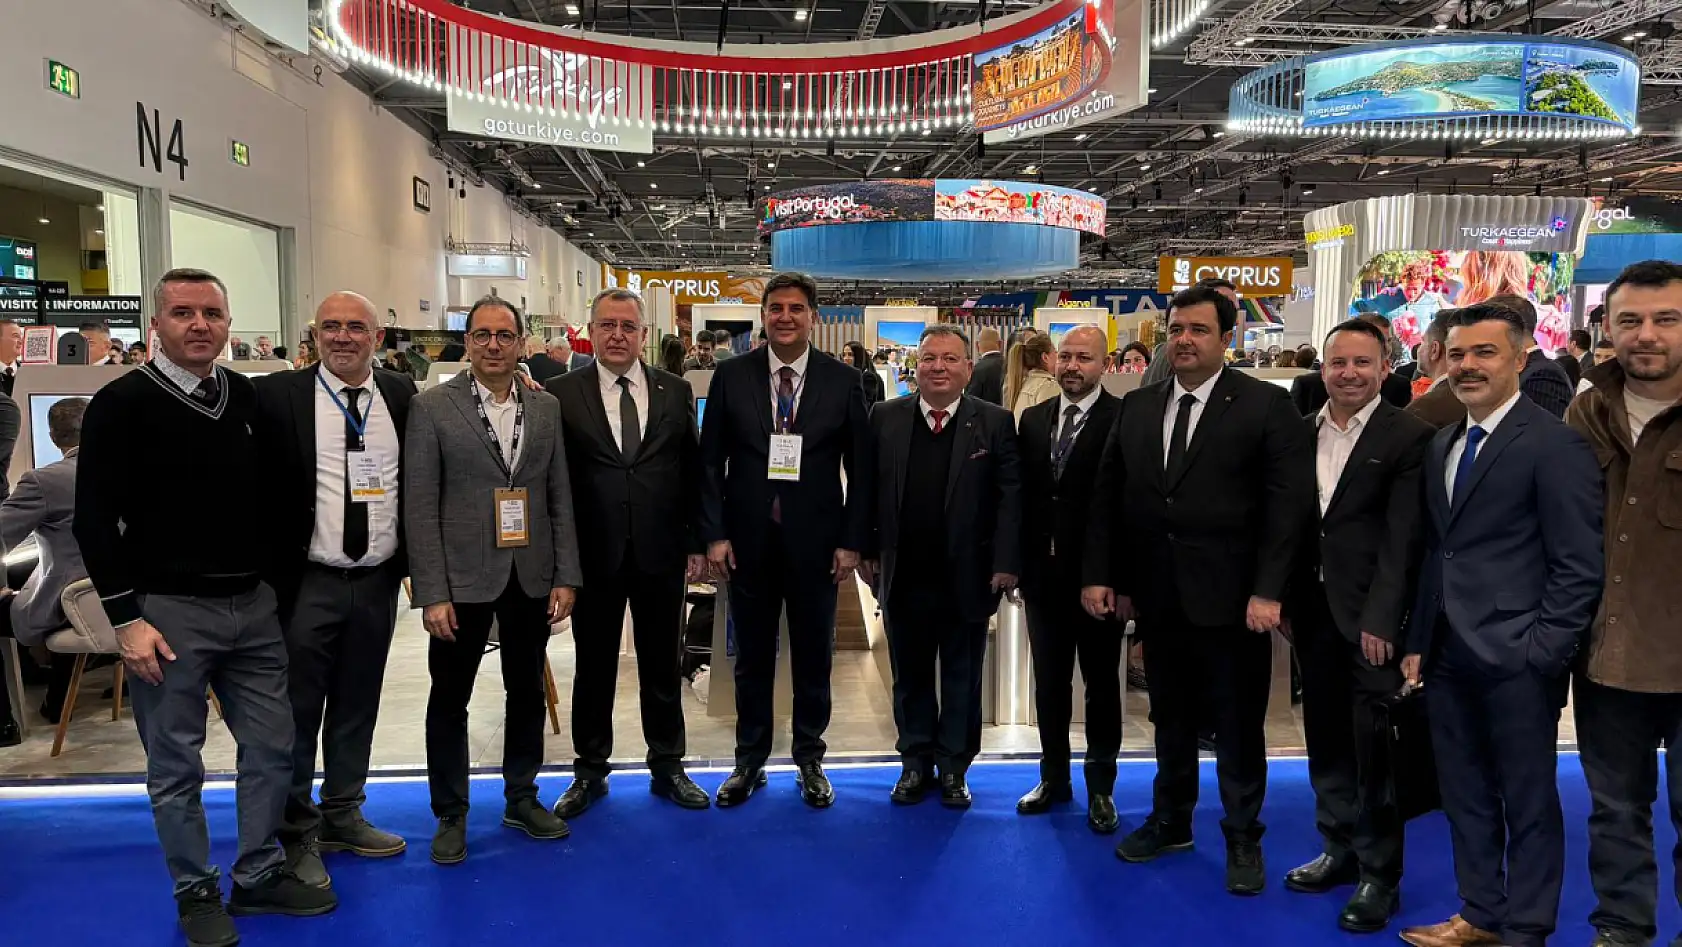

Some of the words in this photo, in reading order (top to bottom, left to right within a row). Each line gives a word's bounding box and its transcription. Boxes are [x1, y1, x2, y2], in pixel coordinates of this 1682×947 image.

[484, 118, 619, 146] goturkiye.com
[136, 101, 189, 182] N4
[1460, 227, 1557, 237] TURKAEGEAN
[1195, 265, 1281, 287] CYPRUS
[53, 299, 140, 310] INFORMATION
[67, 344, 76, 357] 3
